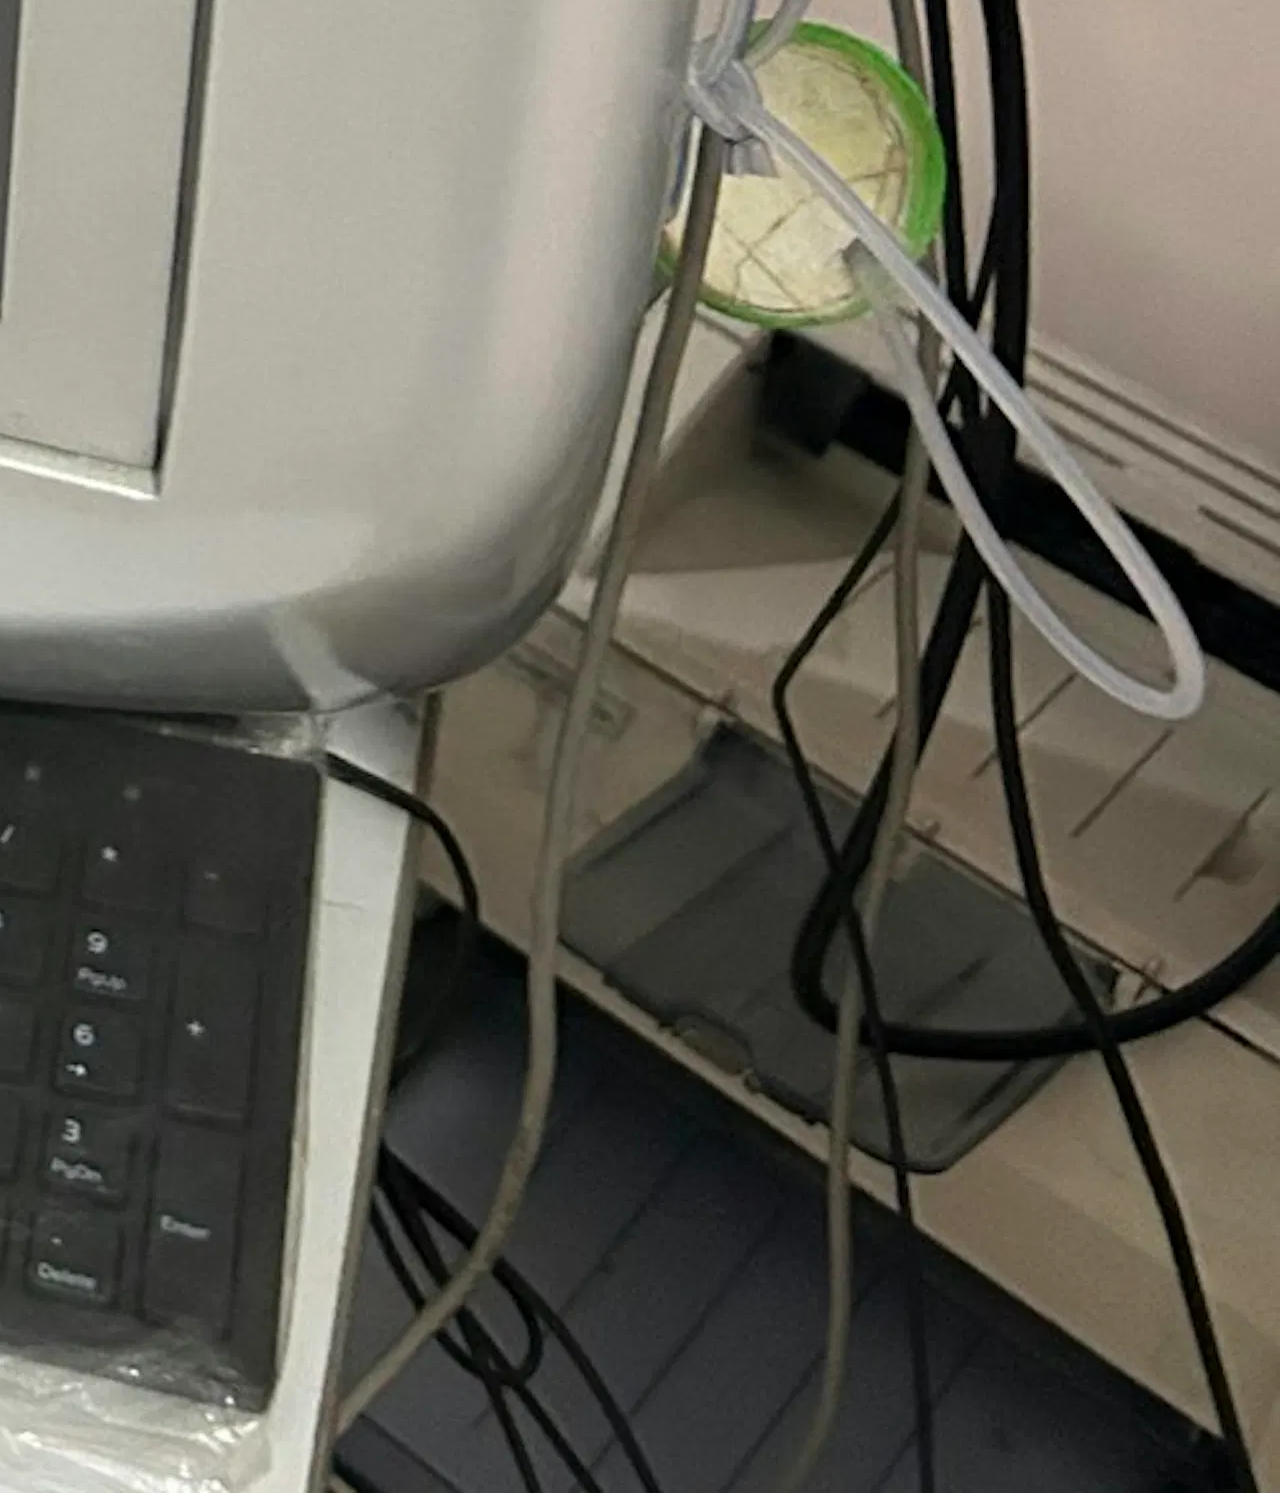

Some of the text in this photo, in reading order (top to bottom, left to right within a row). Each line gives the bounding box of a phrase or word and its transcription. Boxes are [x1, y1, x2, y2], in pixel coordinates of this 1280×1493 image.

[87, 932, 108, 954] 9
[74, 1024, 94, 1046] 6
[62, 1119, 81, 1143] 3
